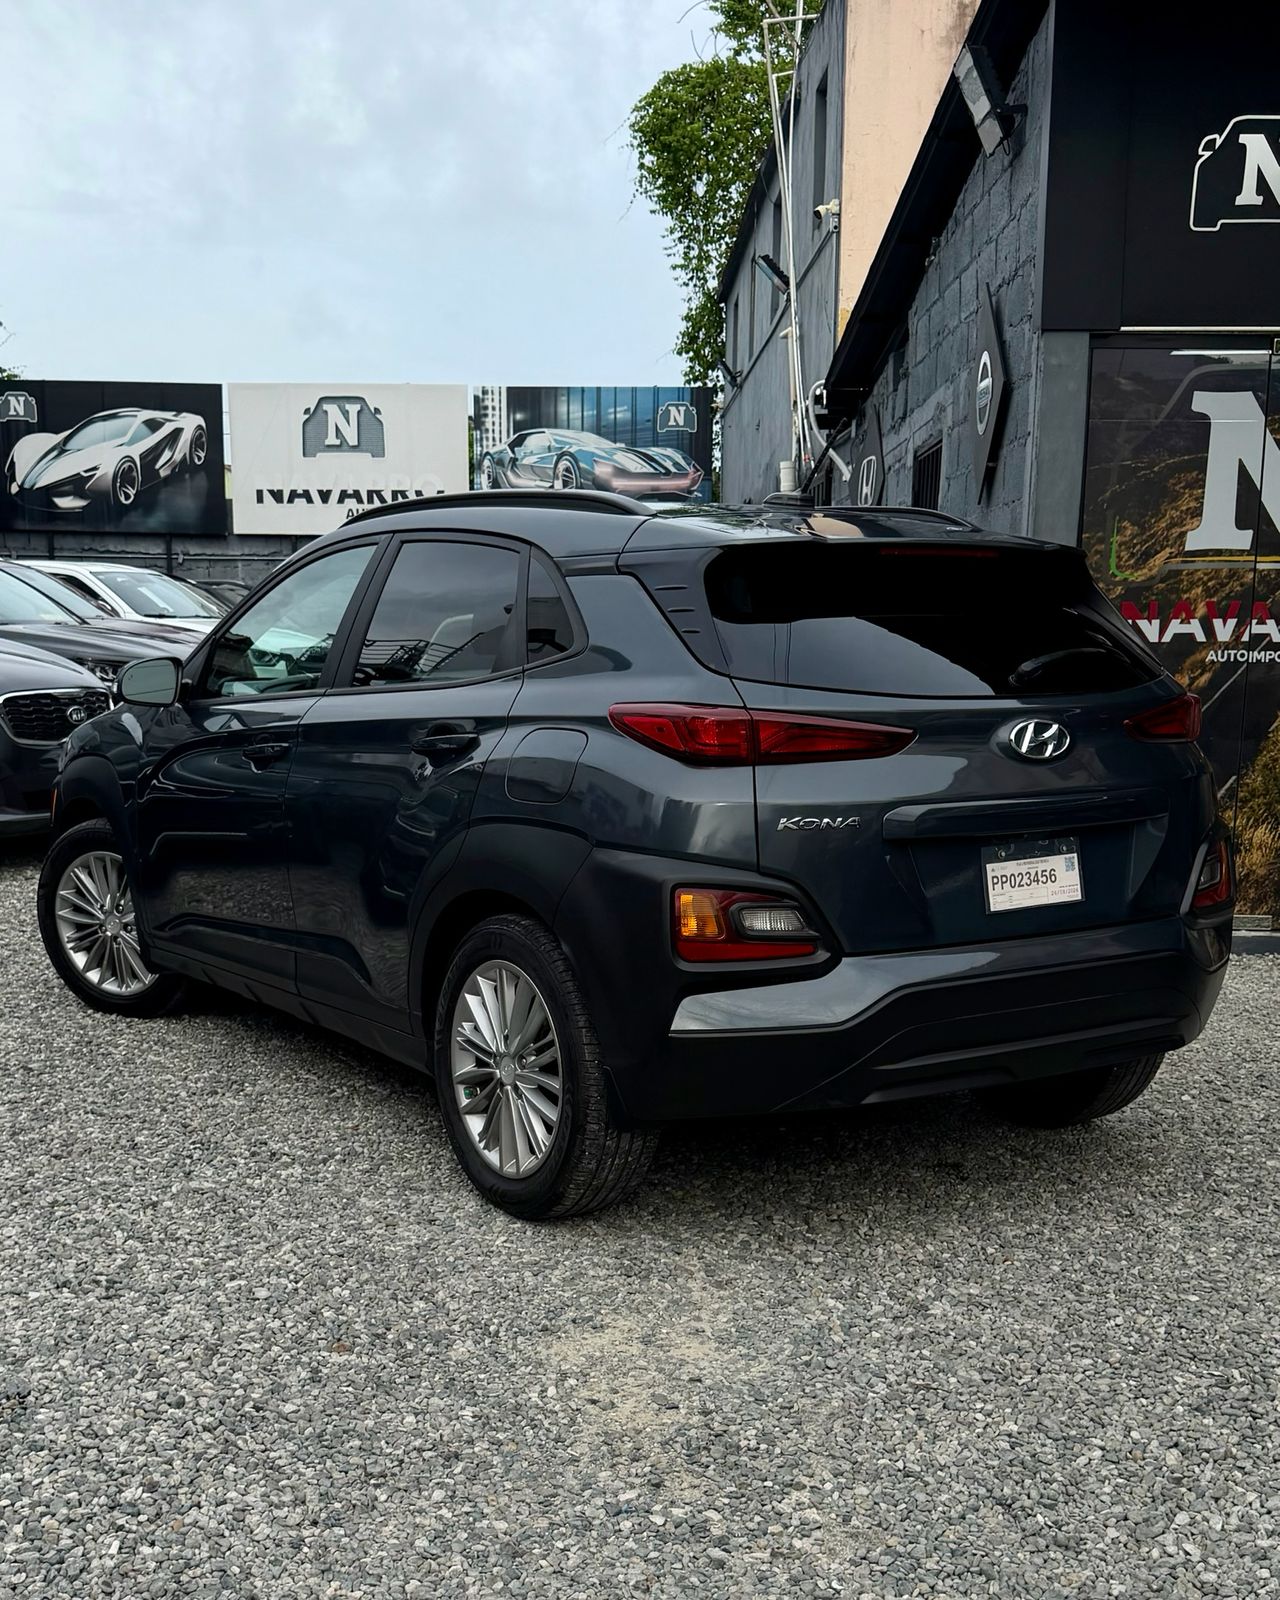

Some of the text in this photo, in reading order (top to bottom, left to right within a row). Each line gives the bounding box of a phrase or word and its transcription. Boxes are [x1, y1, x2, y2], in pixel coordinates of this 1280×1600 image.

[8, 396, 26, 416] N
[668, 406, 687, 426] N
[322, 403, 362, 447] N
[776, 816, 861, 831] KONA
[991, 868, 1057, 891] PP023456
